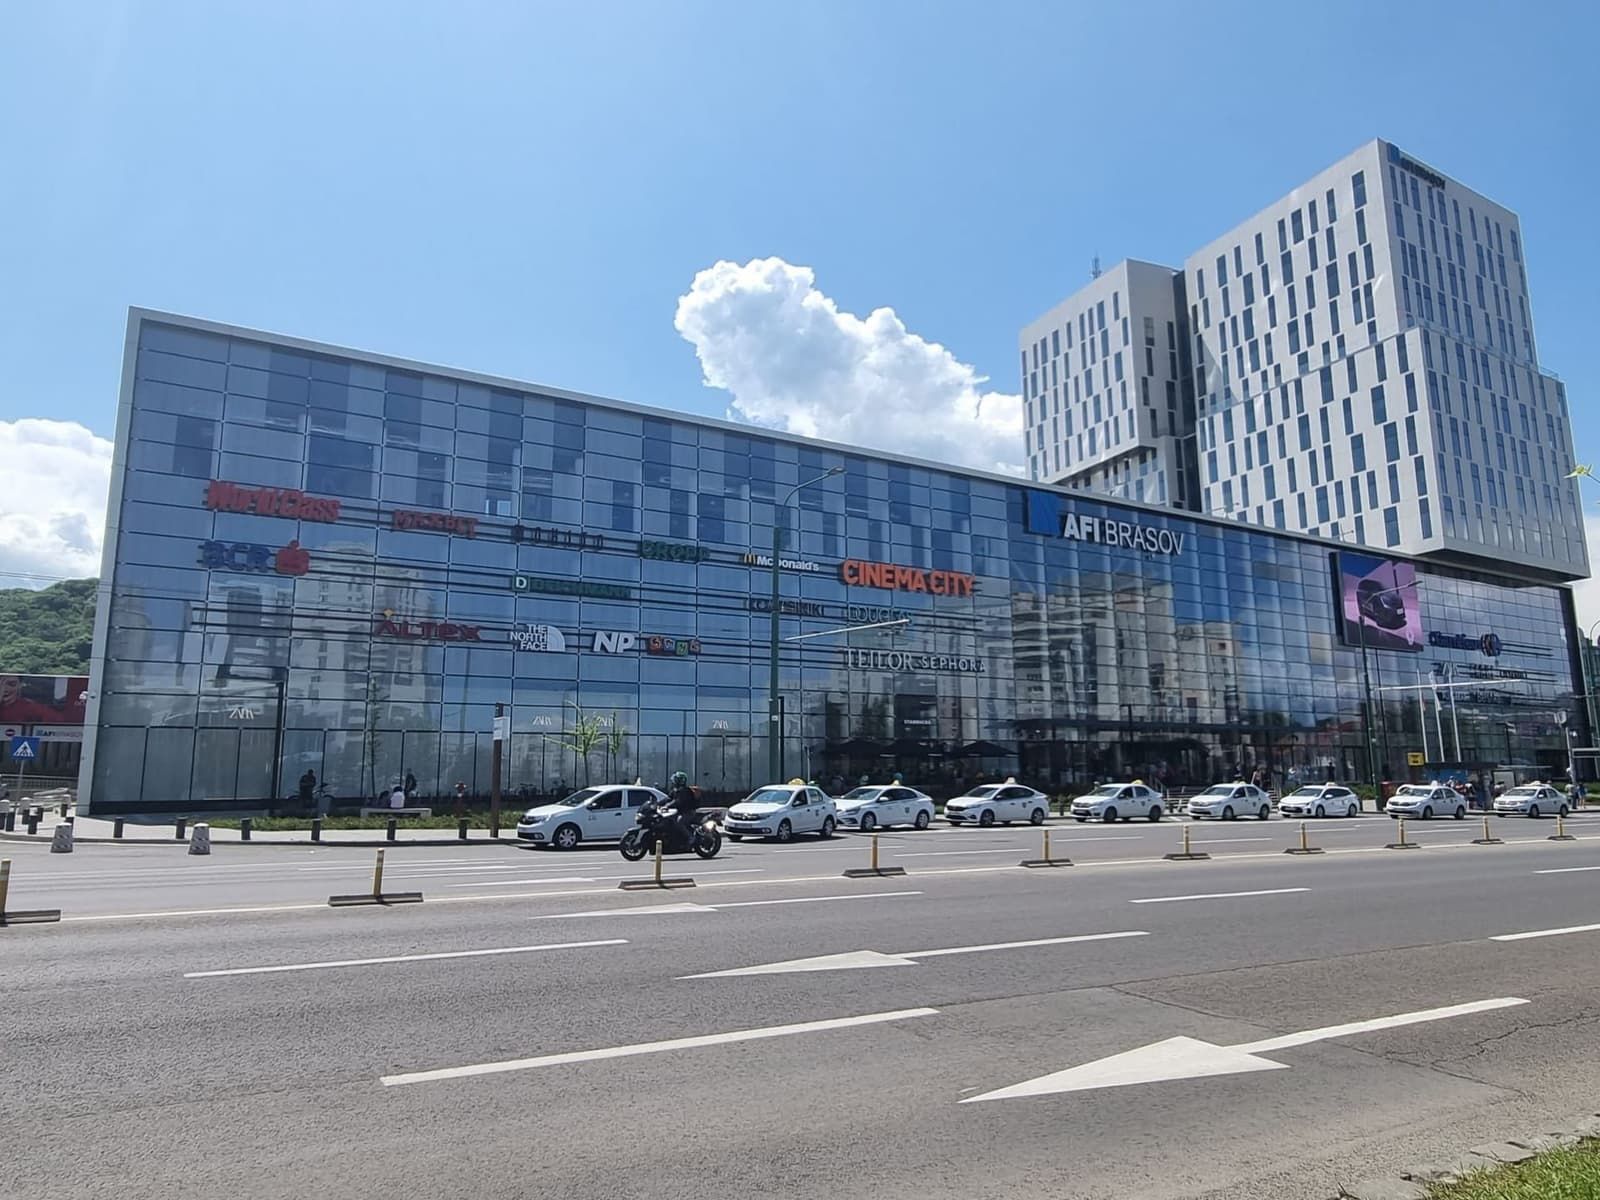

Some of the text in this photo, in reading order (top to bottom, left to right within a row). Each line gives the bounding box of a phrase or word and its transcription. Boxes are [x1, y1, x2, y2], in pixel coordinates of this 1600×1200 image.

[208, 480, 340, 521] World Class
[1063, 513, 1101, 543] AFI
[202, 539, 271, 572] BCR
[756, 556, 820, 571] Mconald's
[842, 559, 976, 596] CINEMA CITY
[510, 631, 547, 642] NORTH
[526, 623, 548, 634] THE
[520, 641, 548, 651] FACE
[592, 630, 636, 653] NP
[847, 649, 914, 671] TEILOR
[921, 655, 987, 672] SEPHORA
